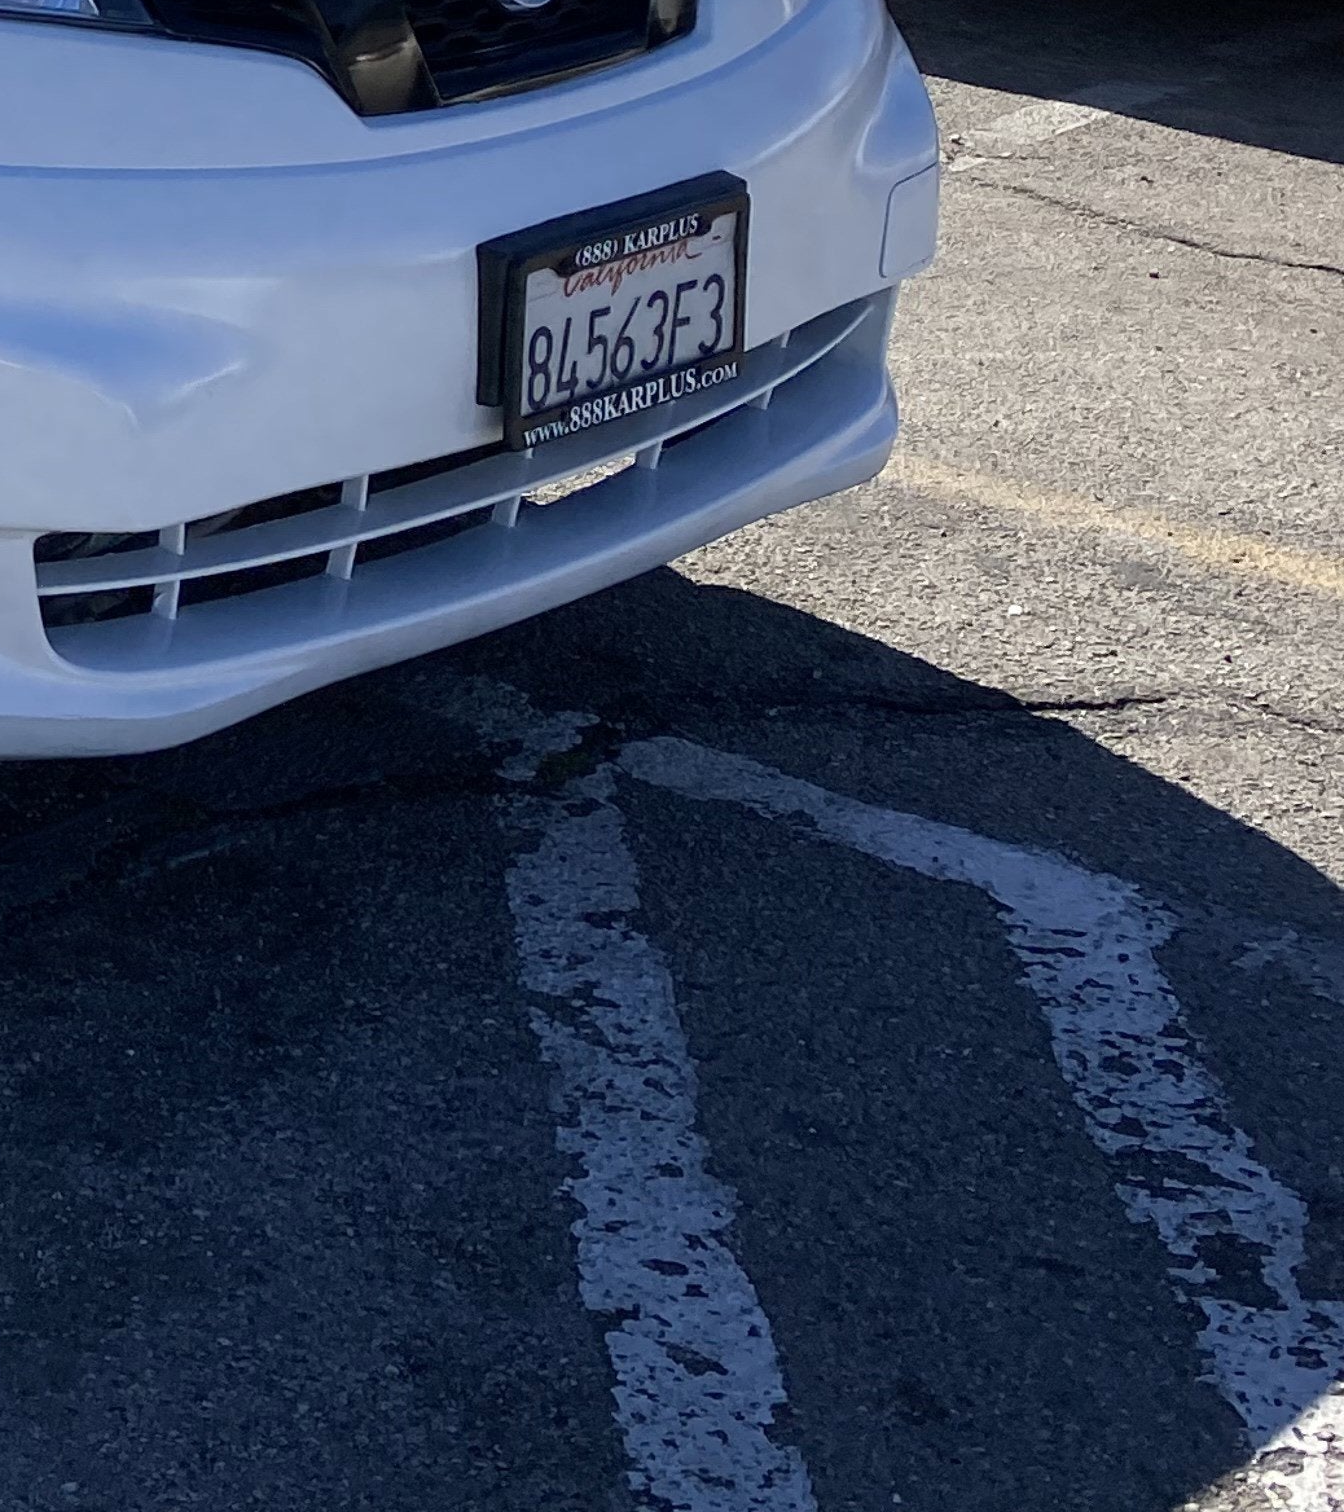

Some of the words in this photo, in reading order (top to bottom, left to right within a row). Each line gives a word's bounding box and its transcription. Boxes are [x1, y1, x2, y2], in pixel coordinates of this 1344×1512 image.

[575, 240, 618, 267] (888)
[624, 213, 699, 254] KARPLUS
[528, 274, 725, 409] 84563F3
